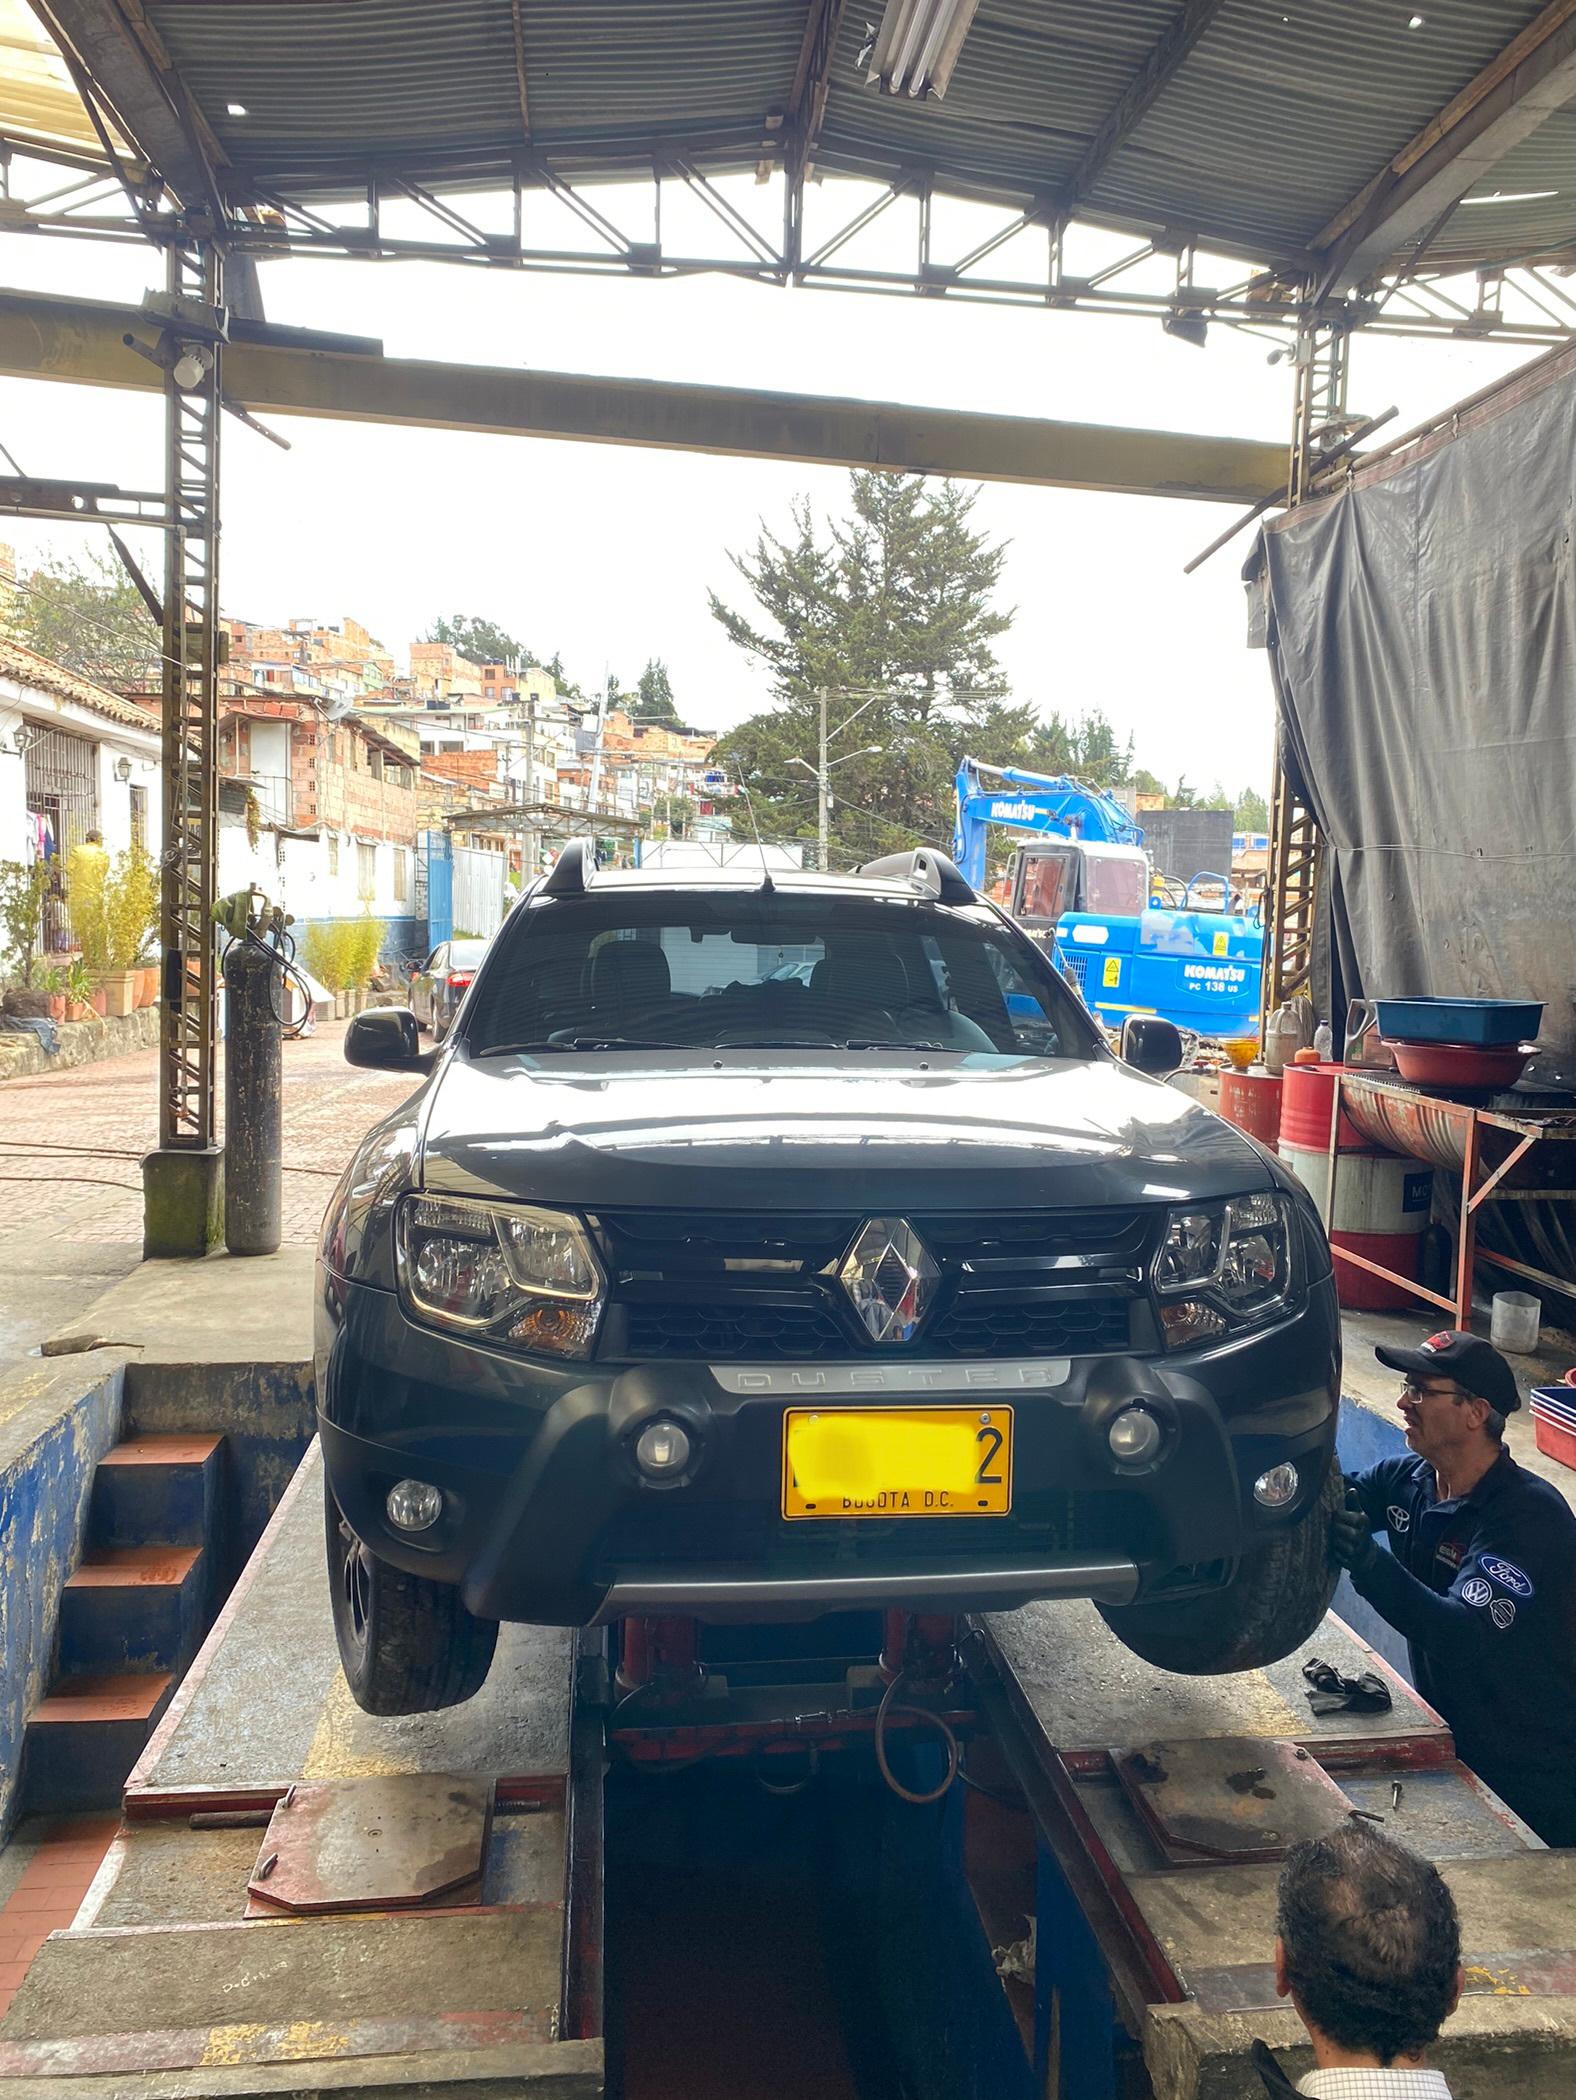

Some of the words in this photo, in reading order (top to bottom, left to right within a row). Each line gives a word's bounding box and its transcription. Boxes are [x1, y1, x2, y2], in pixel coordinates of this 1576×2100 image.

[991, 800, 1035, 821] KOMATSU
[1184, 964, 1245, 982] KOMATSU
[1189, 982, 1201, 991] PC
[1205, 981, 1225, 992] 138
[1227, 985, 1239, 993] US
[737, 1366, 1052, 1388] DUSTER
[924, 1491, 953, 1507] D.C.
[1490, 1562, 1526, 1591] Ford
